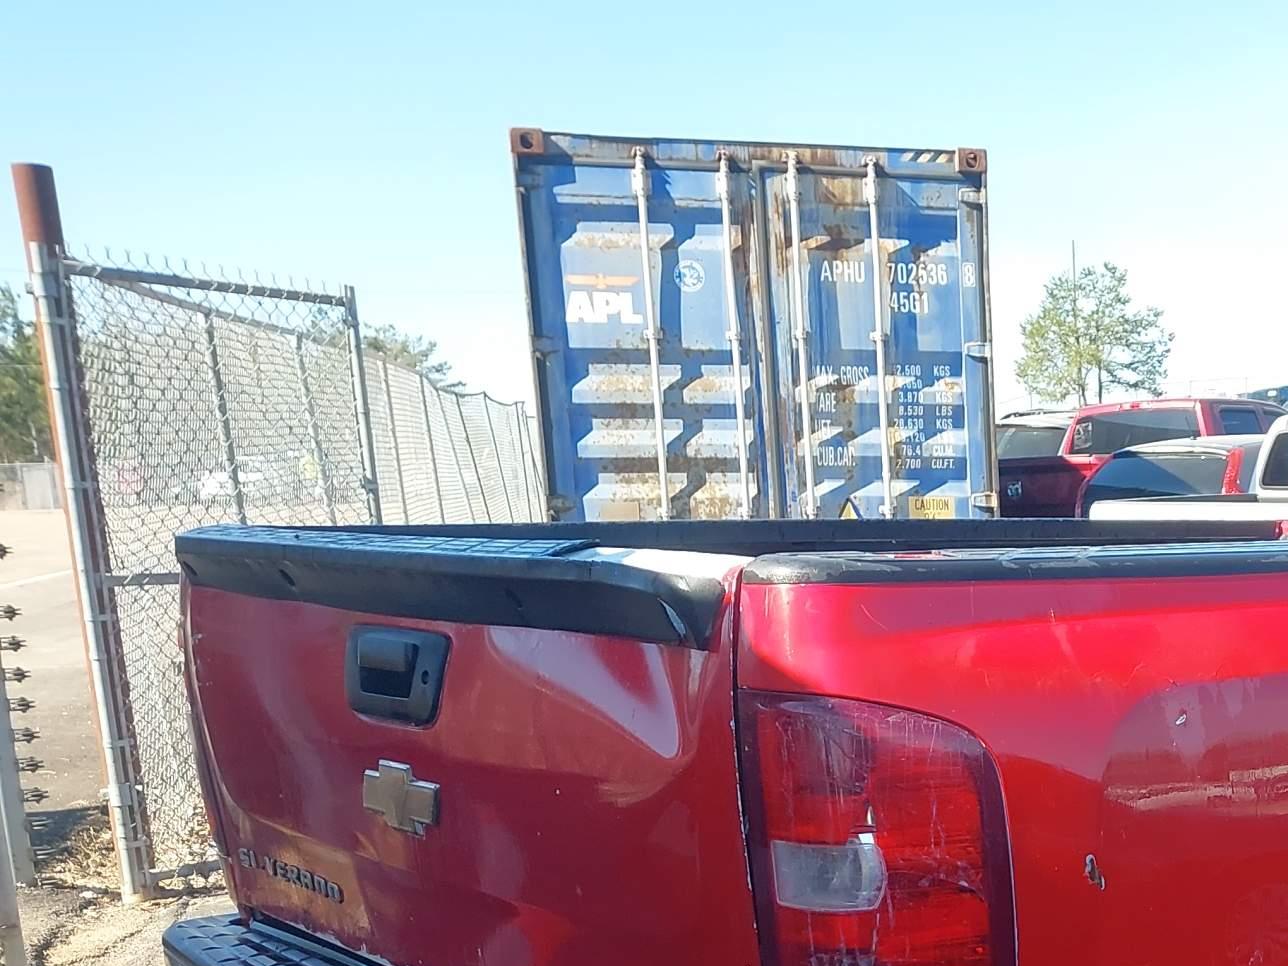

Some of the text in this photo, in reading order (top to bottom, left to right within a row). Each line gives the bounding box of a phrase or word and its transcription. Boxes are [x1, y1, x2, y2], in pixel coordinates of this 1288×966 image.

[820, 260, 865, 283] APHU
[963, 263, 975, 287] 8
[565, 290, 644, 325] APL
[889, 292, 929, 314] 45G1
[840, 365, 870, 386] GROSS
[933, 364, 951, 377] KGS
[935, 391, 953, 403] KGS
[935, 405, 953, 417] LBS
[935, 418, 953, 430] KGS
[914, 498, 949, 511] CAUTION
[237, 847, 345, 904] SIVERADO
